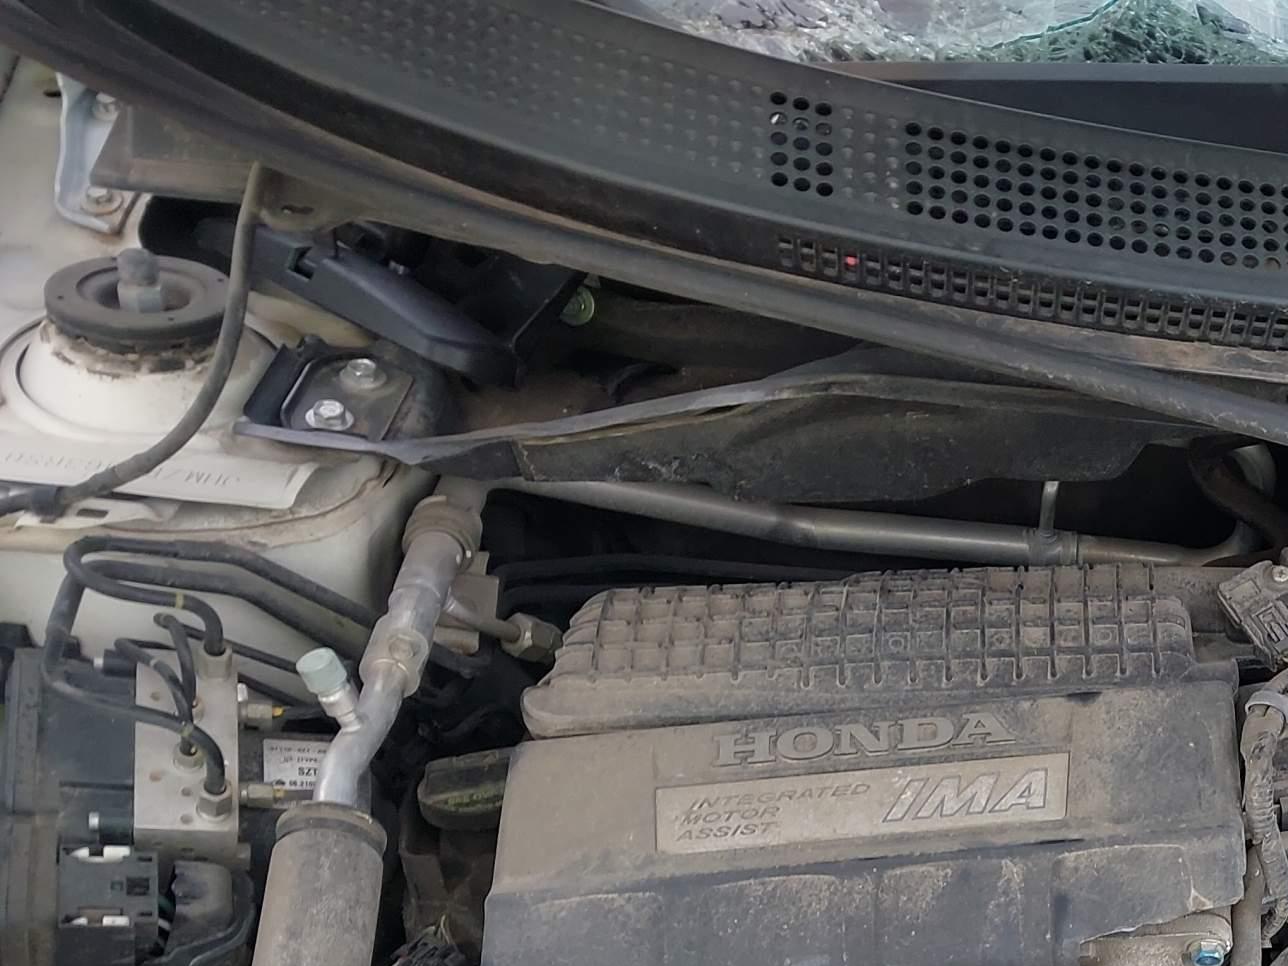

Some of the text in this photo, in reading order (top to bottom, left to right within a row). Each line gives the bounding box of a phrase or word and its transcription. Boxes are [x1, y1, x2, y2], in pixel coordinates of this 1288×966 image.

[711, 711, 1017, 768] HONDA
[689, 783, 871, 811] INTEGRATED
[881, 768, 1049, 823] IMA
[681, 806, 781, 826] MOTOR
[676, 821, 779, 842] ASSIST
